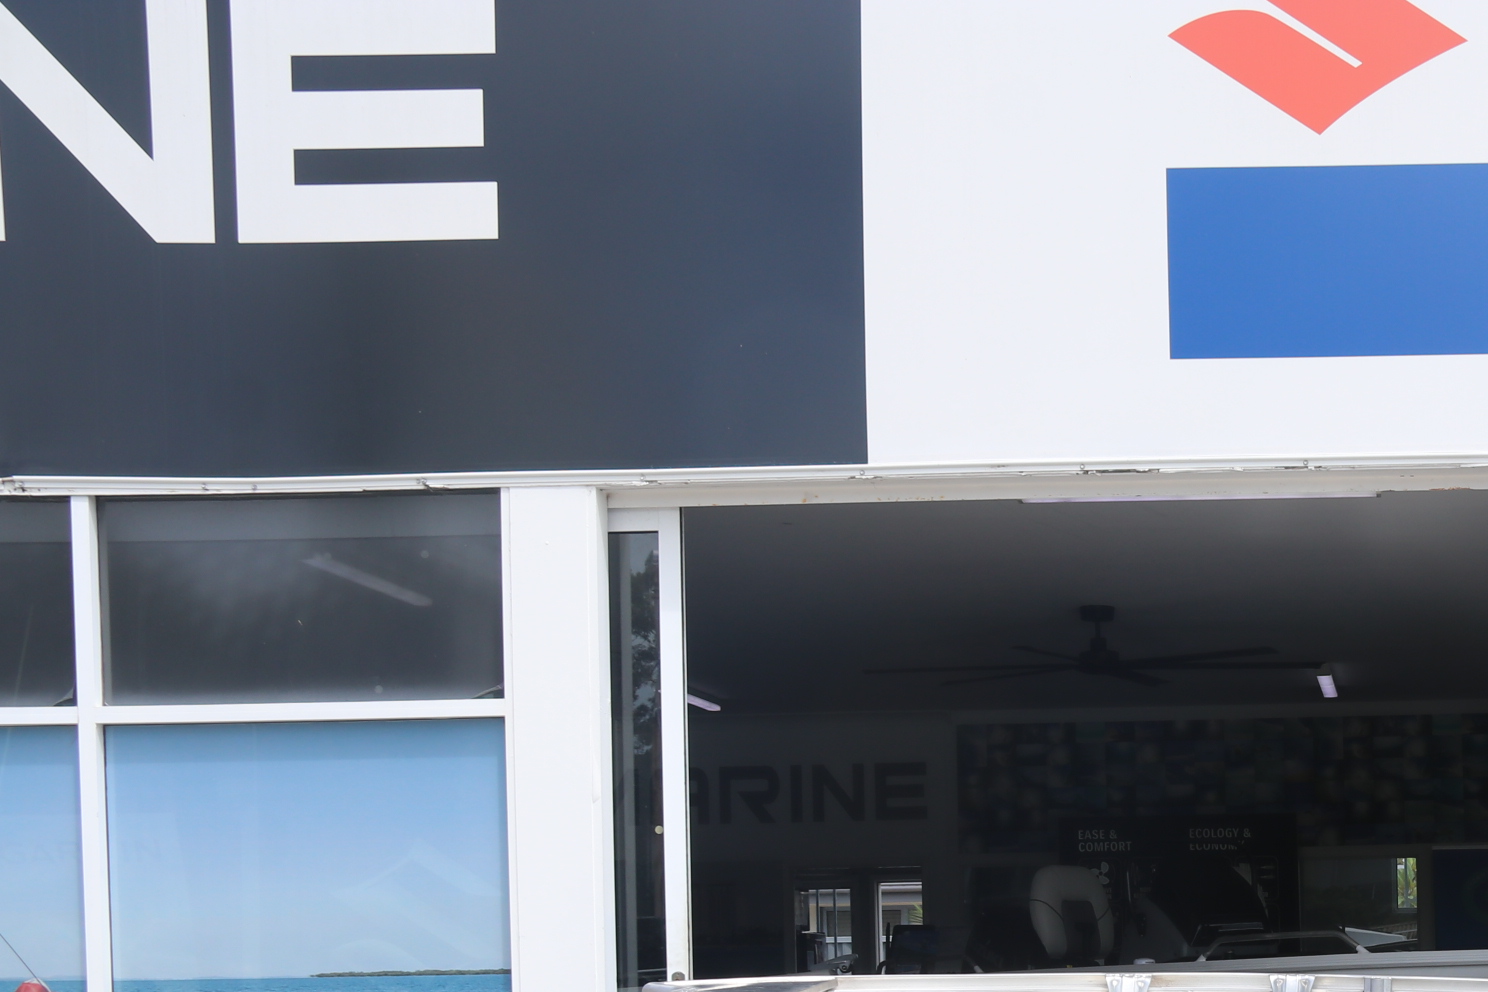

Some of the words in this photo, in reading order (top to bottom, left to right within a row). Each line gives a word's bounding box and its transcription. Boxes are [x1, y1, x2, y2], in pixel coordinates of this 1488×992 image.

[0, 0, 499, 243] NE
[635, 761, 928, 826] ARINE
[1078, 829, 1105, 840] EASE
[1189, 828, 1239, 839] ECOLOGY
[1078, 841, 1133, 853] COMFORT
